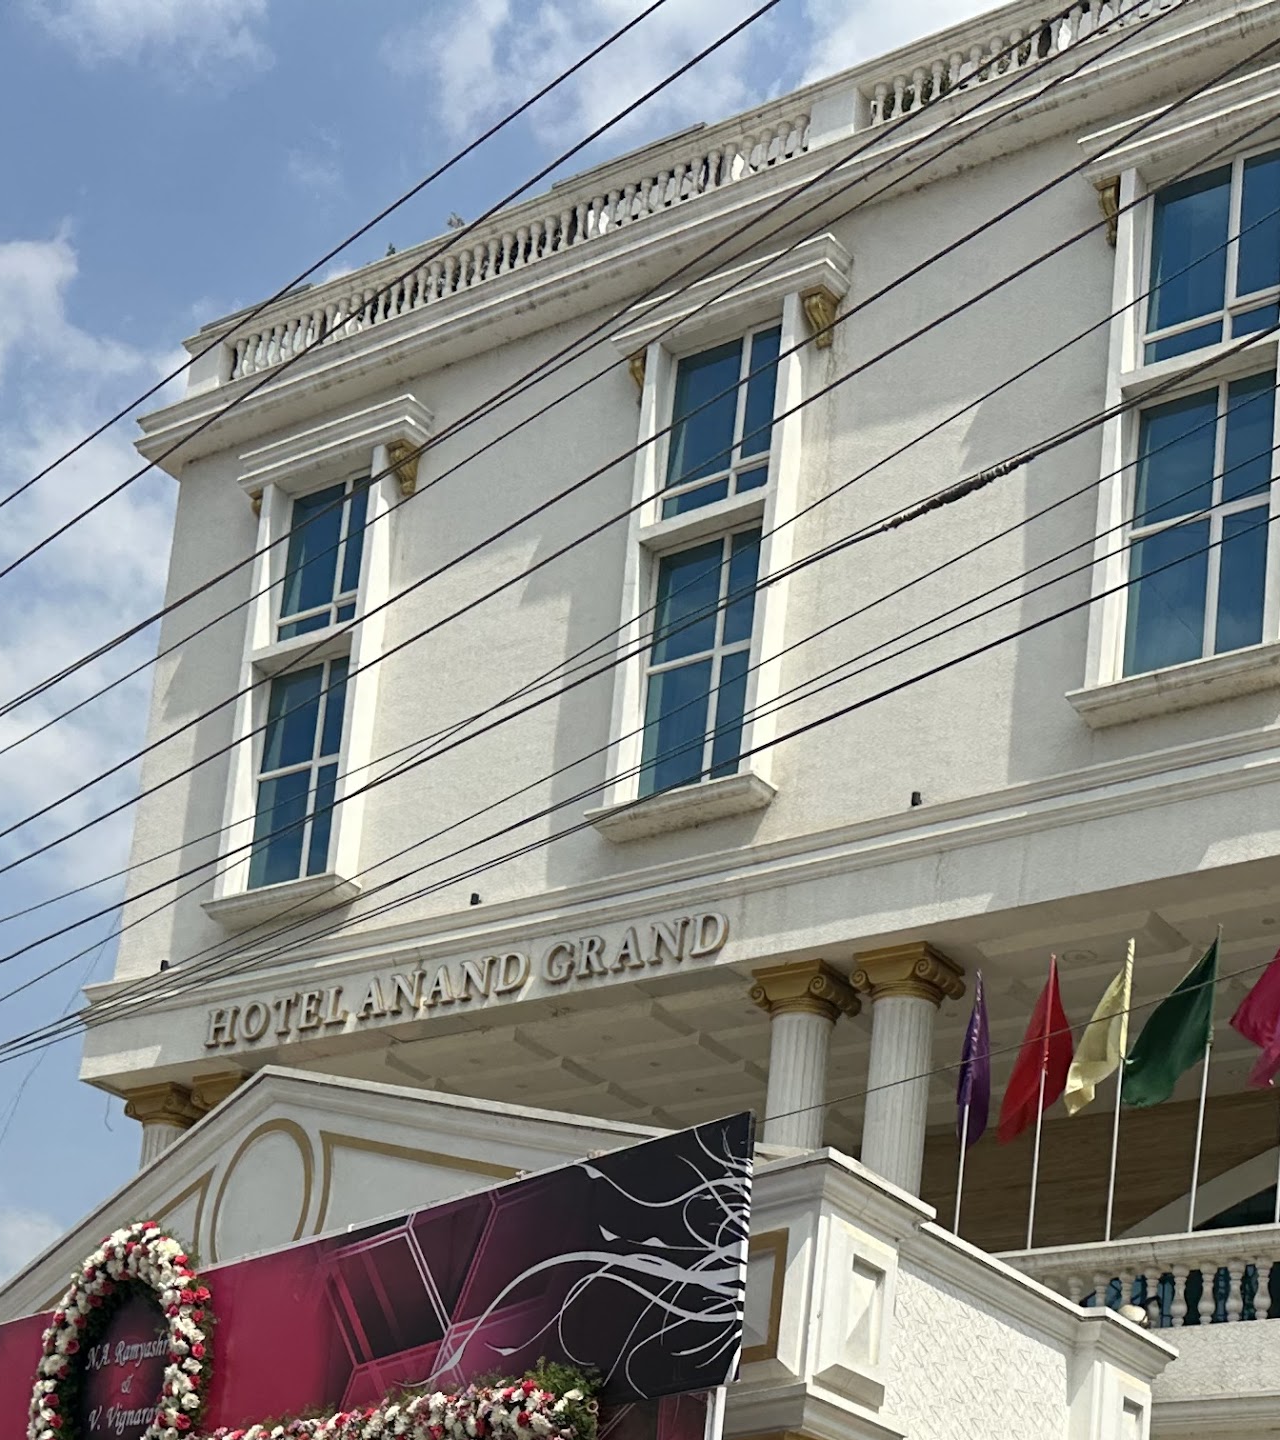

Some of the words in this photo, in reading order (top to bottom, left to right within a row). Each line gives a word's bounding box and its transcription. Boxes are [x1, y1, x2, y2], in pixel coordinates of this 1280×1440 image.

[204, 984, 350, 1050] HOTEL
[354, 950, 533, 1021] ANAND
[541, 910, 731, 985] GRAND
[114, 1329, 170, 1368] Ramyashr
